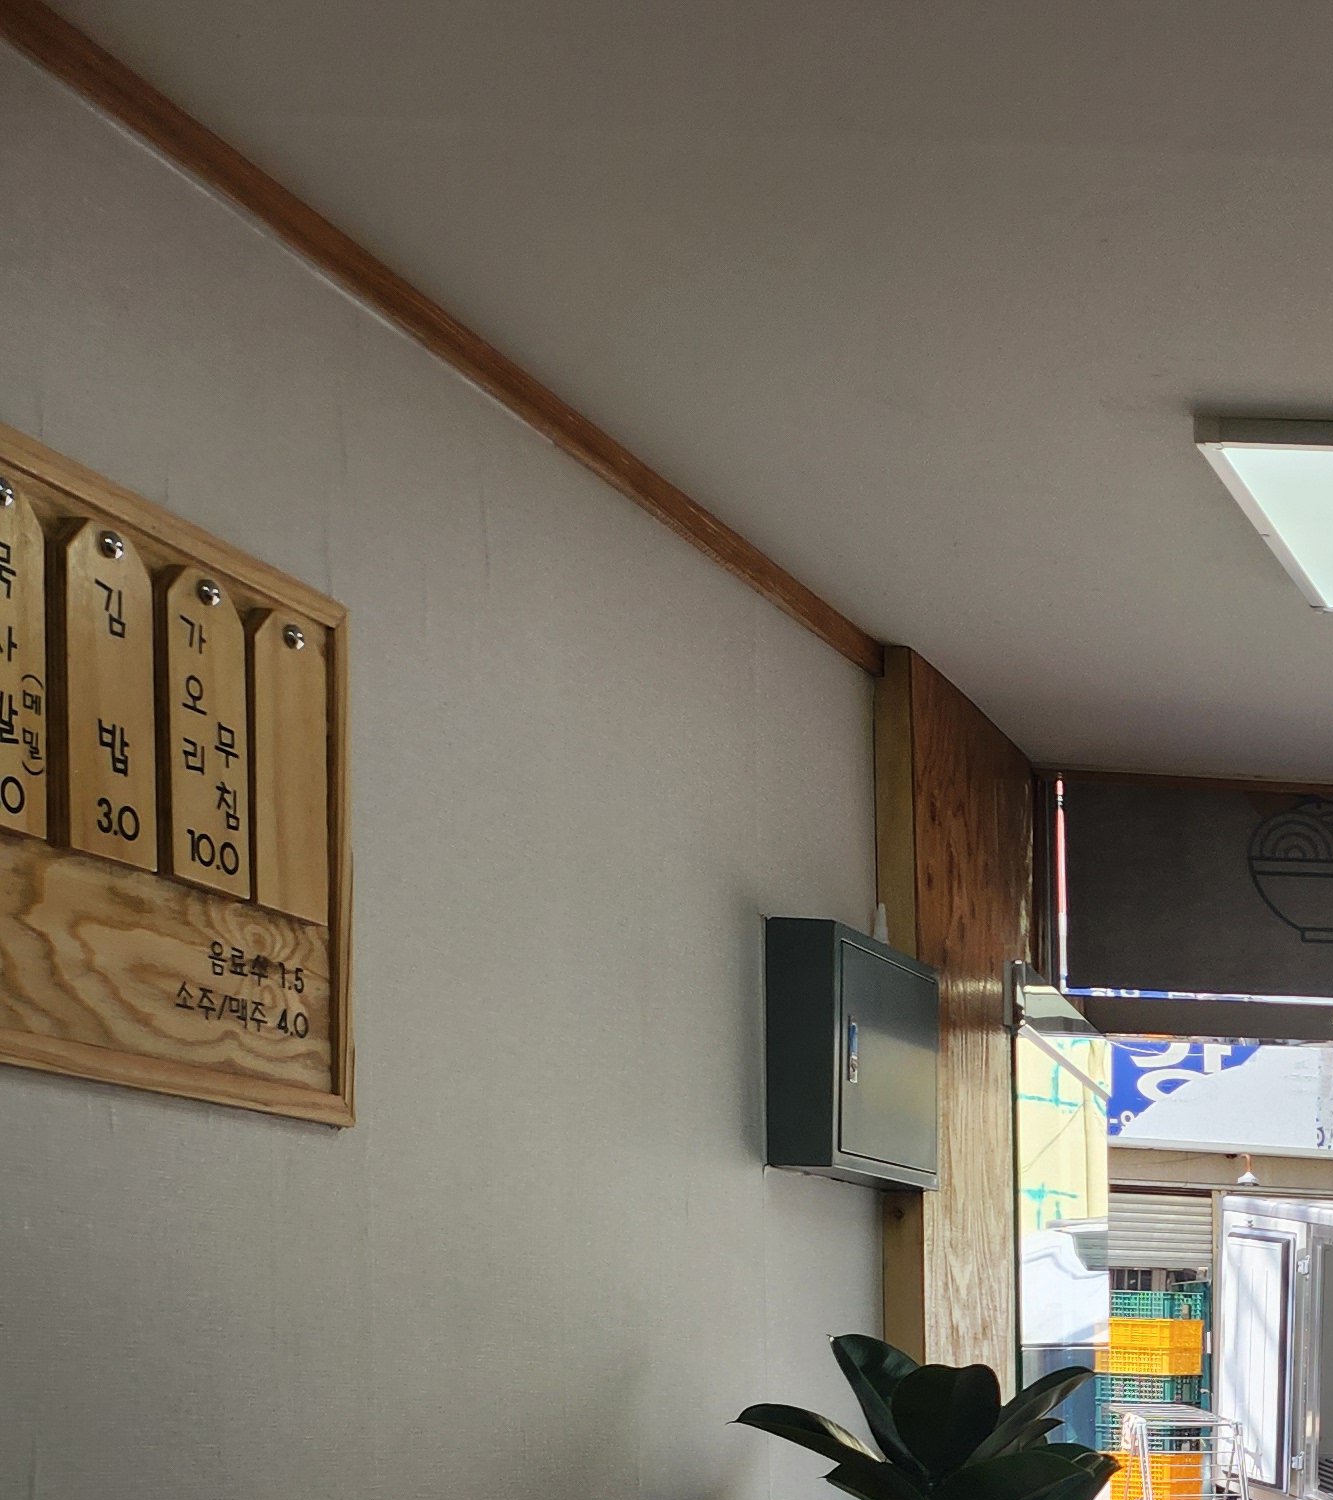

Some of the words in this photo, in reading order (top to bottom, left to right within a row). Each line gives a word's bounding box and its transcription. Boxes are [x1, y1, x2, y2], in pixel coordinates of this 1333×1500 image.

[214, 721, 240, 832] 무침
[96, 797, 140, 842] 3.0
[187, 828, 240, 876] 10.0
[207, 940, 269, 987] 음료수
[277, 961, 305, 994] 1.5
[175, 981, 268, 1033] 소주/맥주
[277, 1008, 309, 1039] 4.0
